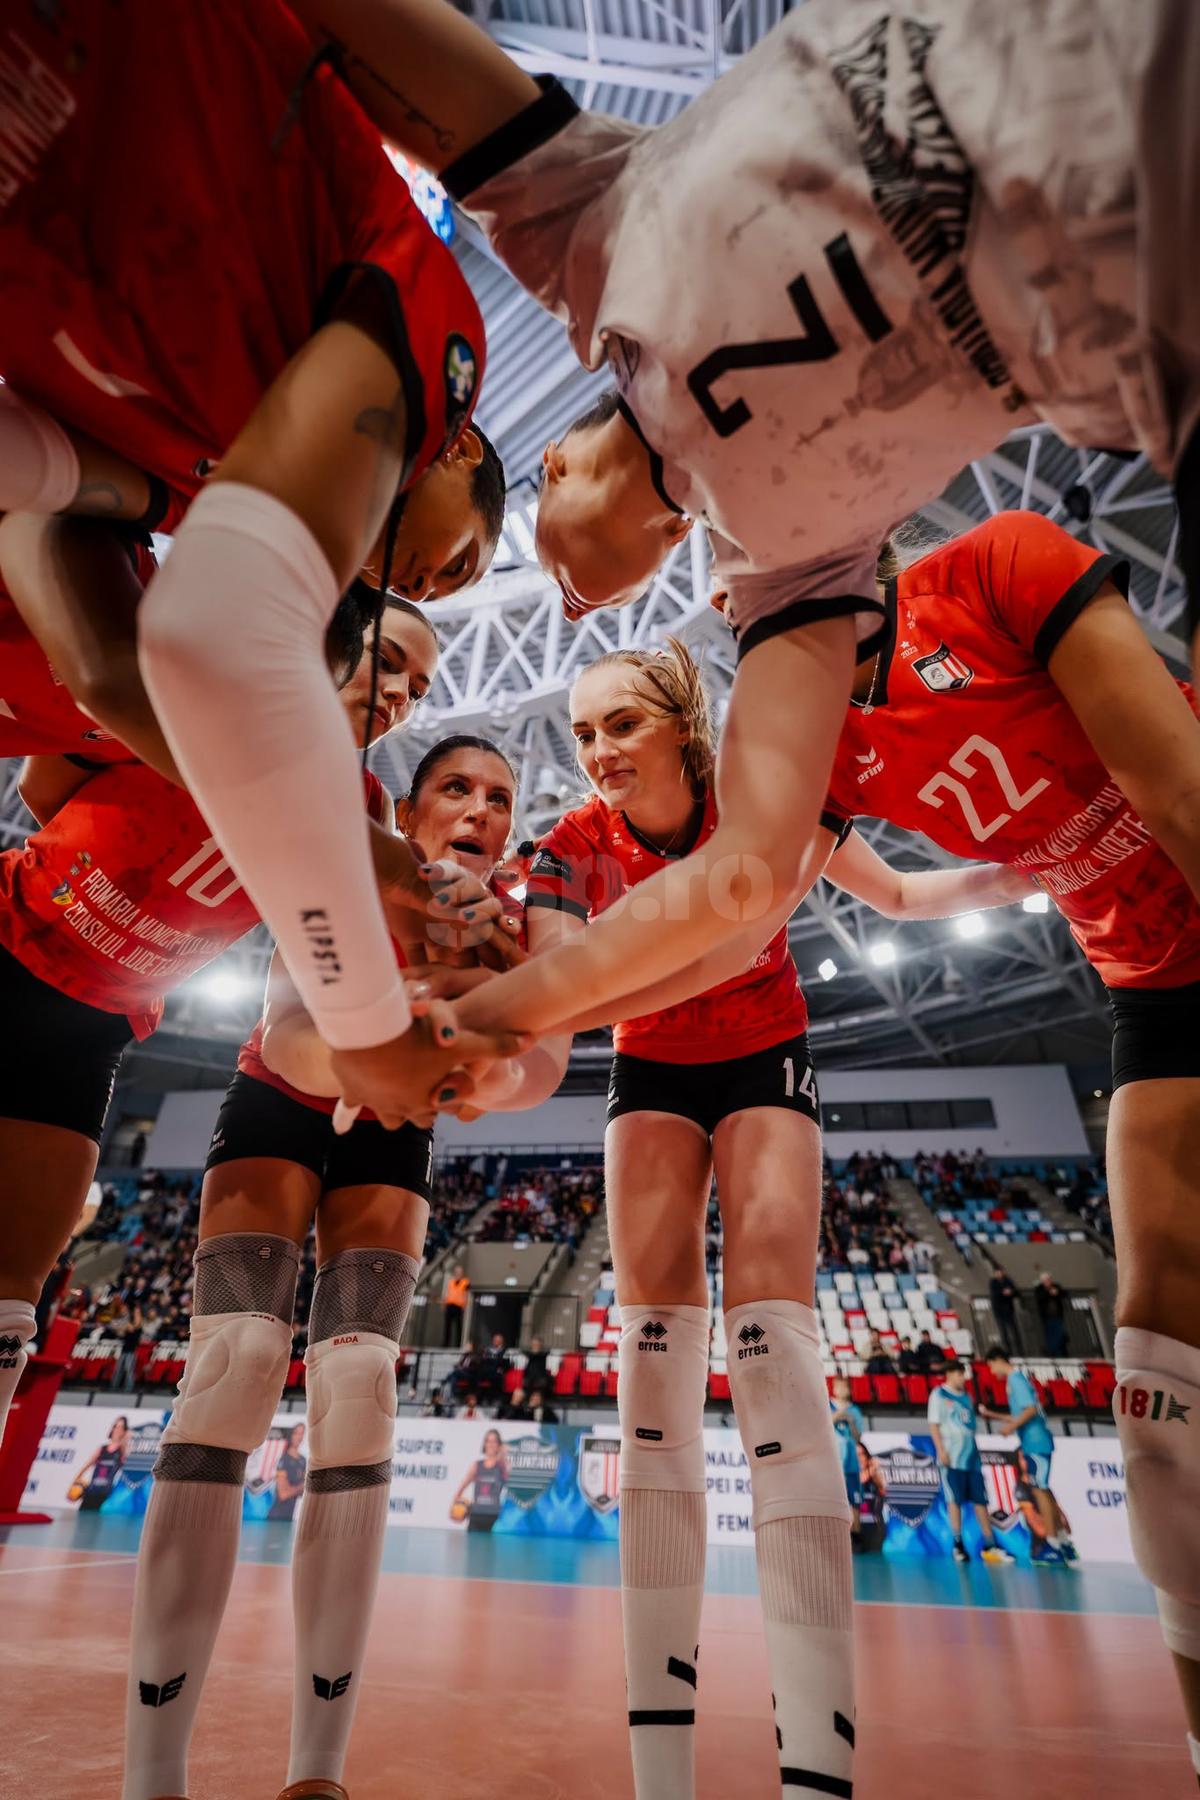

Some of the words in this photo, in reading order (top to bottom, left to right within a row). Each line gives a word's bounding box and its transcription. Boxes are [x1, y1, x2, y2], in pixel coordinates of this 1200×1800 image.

[917, 734, 1051, 843] 22
[167, 836, 243, 908] 10
[80, 867, 141, 929] PRIMĂRIA
[63, 901, 127, 959] CONSILIUL
[783, 1057, 817, 1110] 14
[333, 1335, 359, 1346] BADA
[1120, 1386, 1164, 1420] 181
[396, 1438, 444, 1455] SUPER
[1087, 1489, 1127, 1508] CUP
[717, 1514, 749, 1531] FEM
